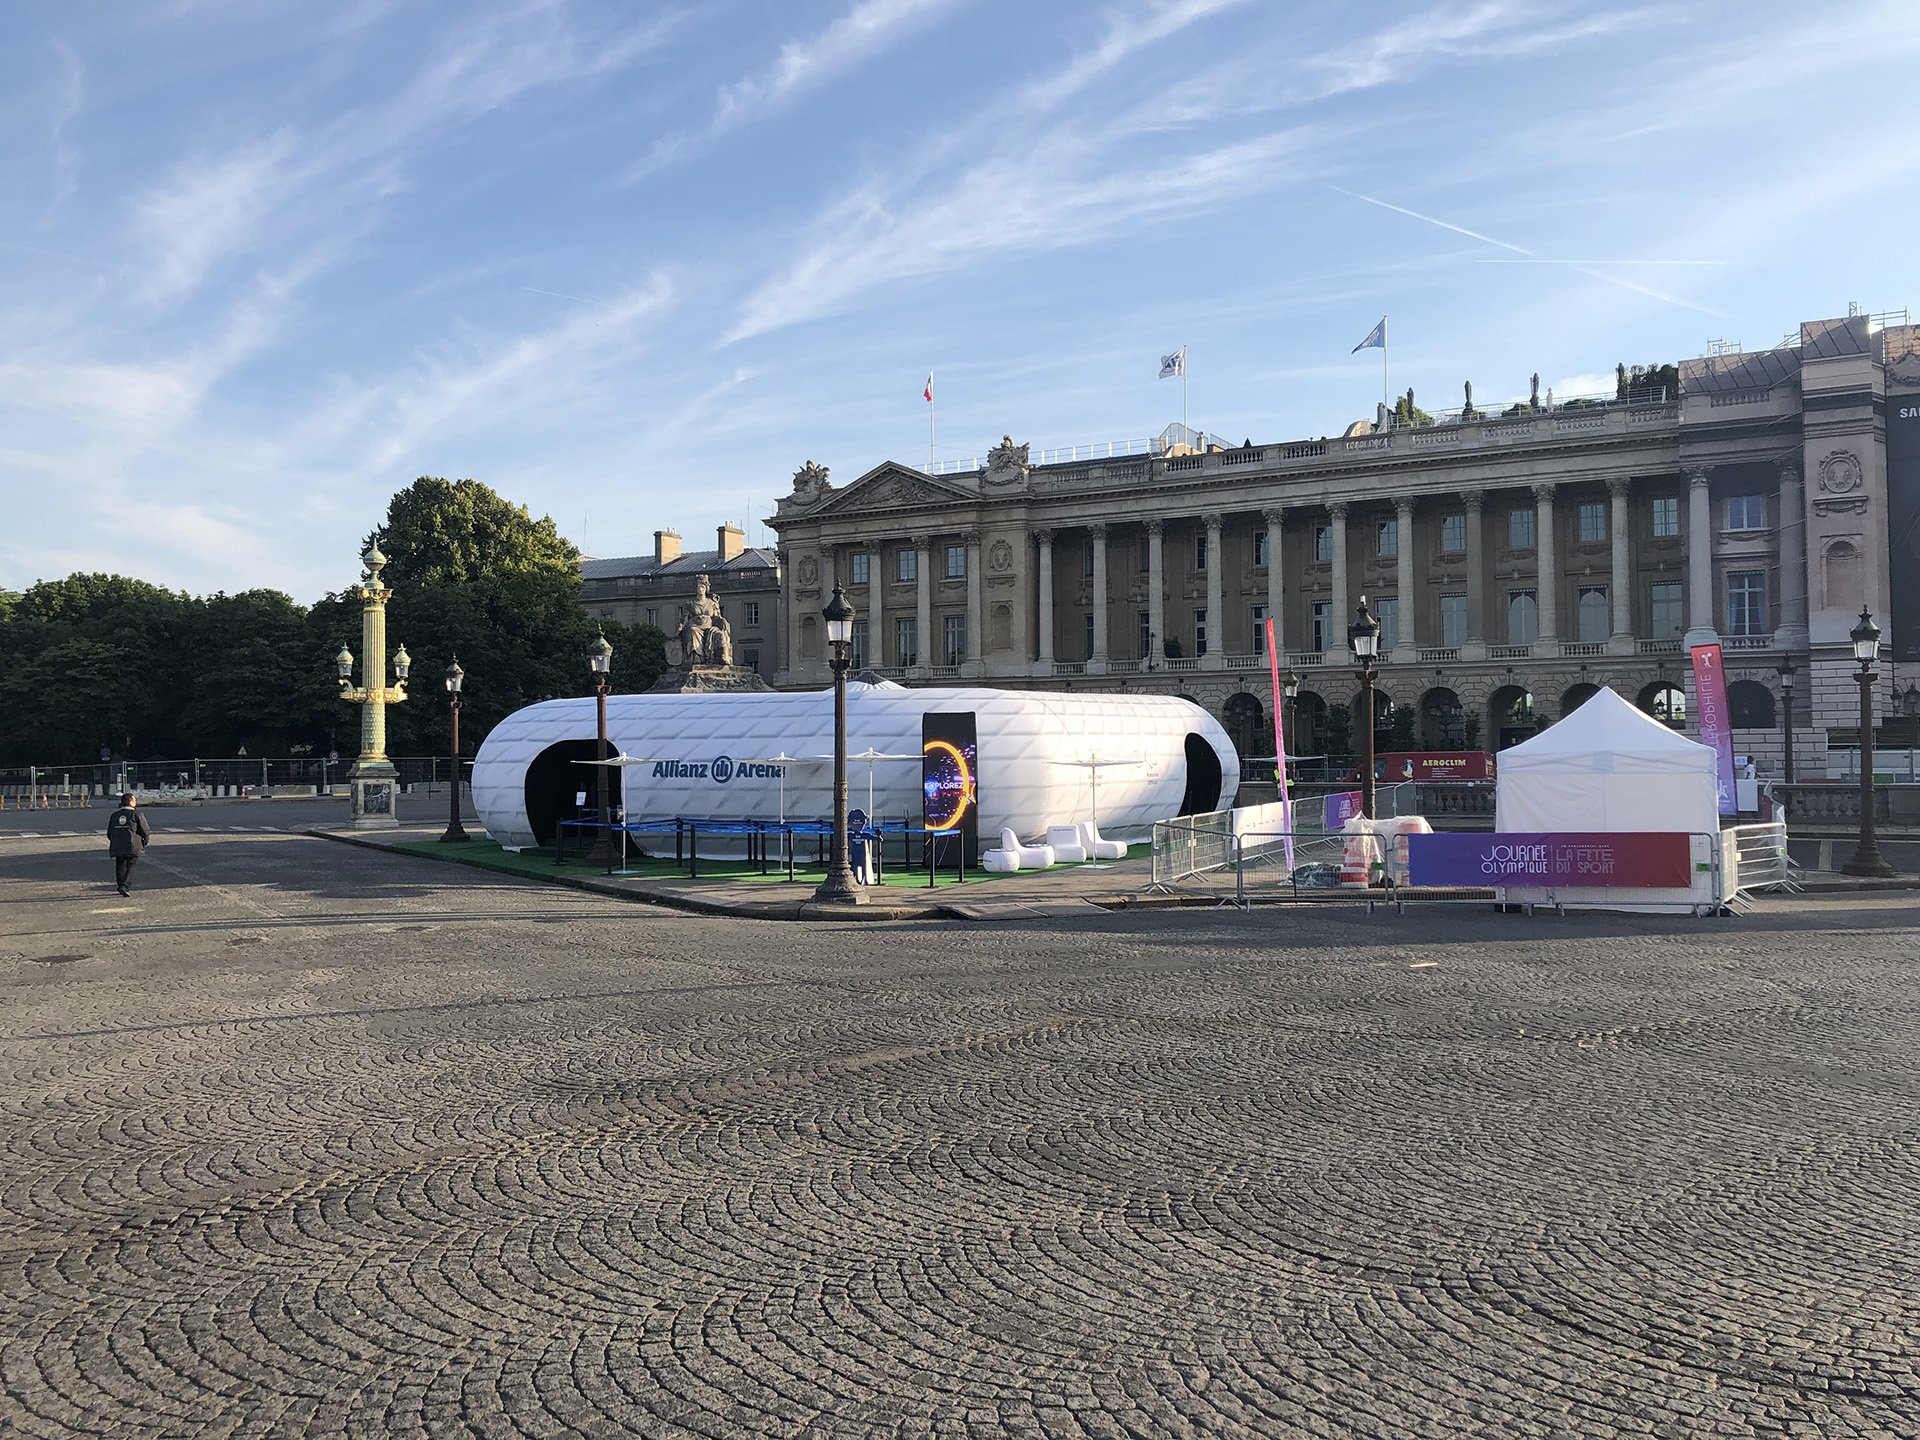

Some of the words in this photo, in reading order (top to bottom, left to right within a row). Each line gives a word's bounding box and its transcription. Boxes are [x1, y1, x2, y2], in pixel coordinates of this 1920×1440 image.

[652, 759, 708, 778] Allianz
[735, 762, 786, 778] Arena
[1422, 759, 1466, 767] AEROCLIM
[1481, 844, 1547, 861] JOURNÉE
[1556, 848, 1574, 861] LA
[1481, 861, 1548, 874] OLYMPIQUE
[1556, 861, 1572, 874] DU
[1577, 861, 1615, 874] SPORT
